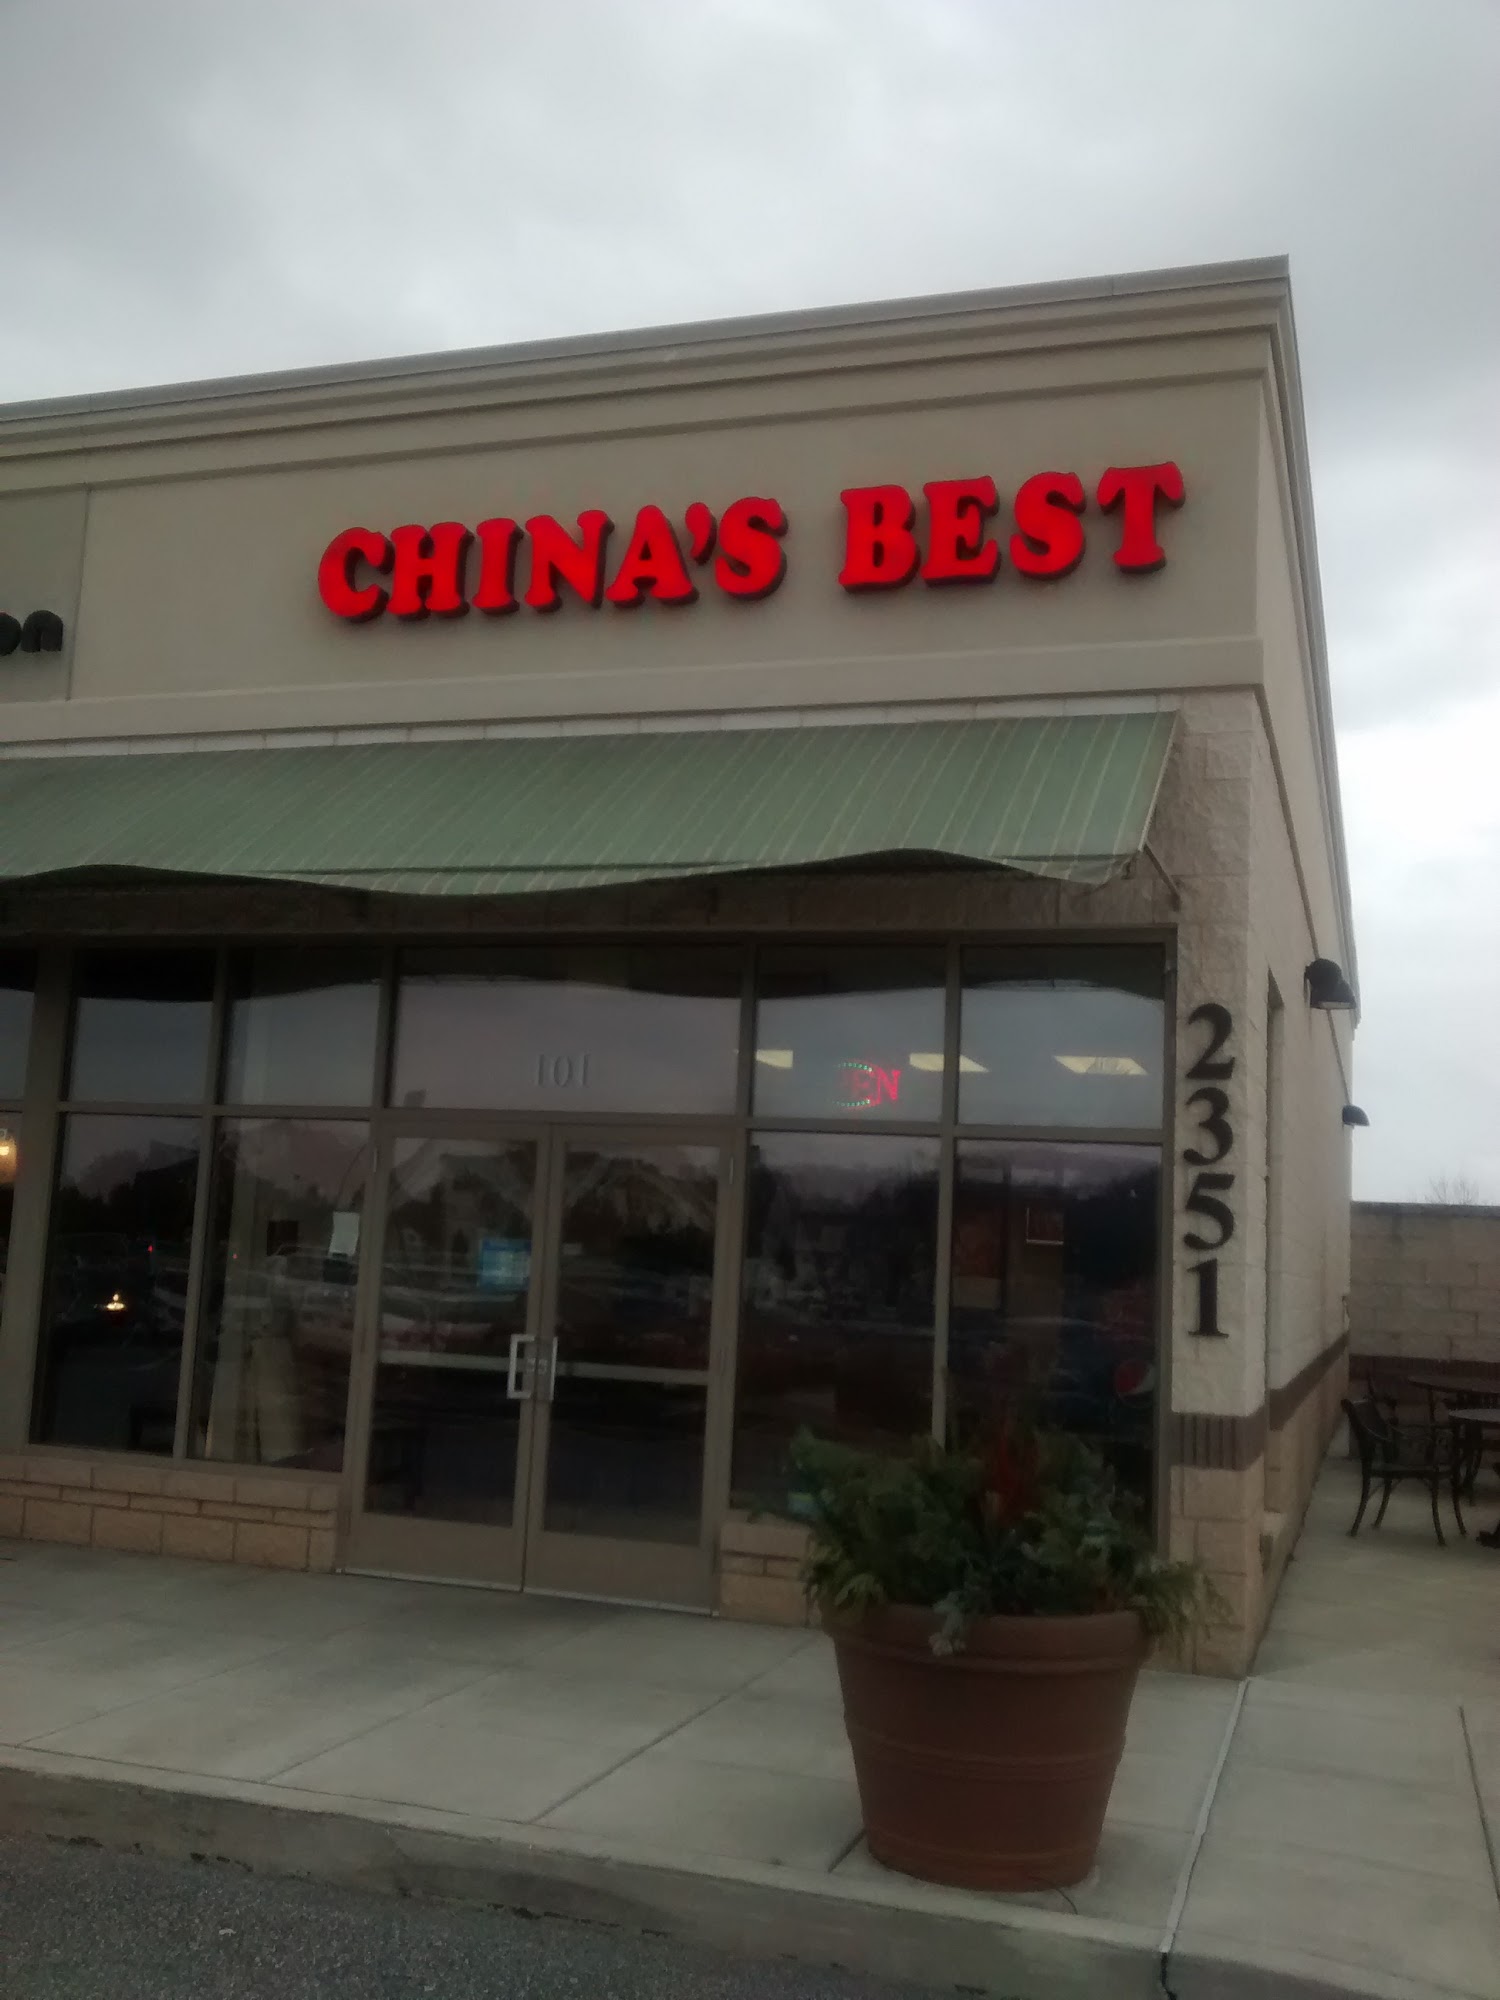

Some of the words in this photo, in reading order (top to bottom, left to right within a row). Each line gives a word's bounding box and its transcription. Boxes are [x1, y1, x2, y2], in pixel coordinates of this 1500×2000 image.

[318, 497, 789, 622] CHINA'S
[839, 462, 1184, 590] BEST
[535, 1051, 591, 1088] 101
[1183, 1003, 1236, 1339] 2351
